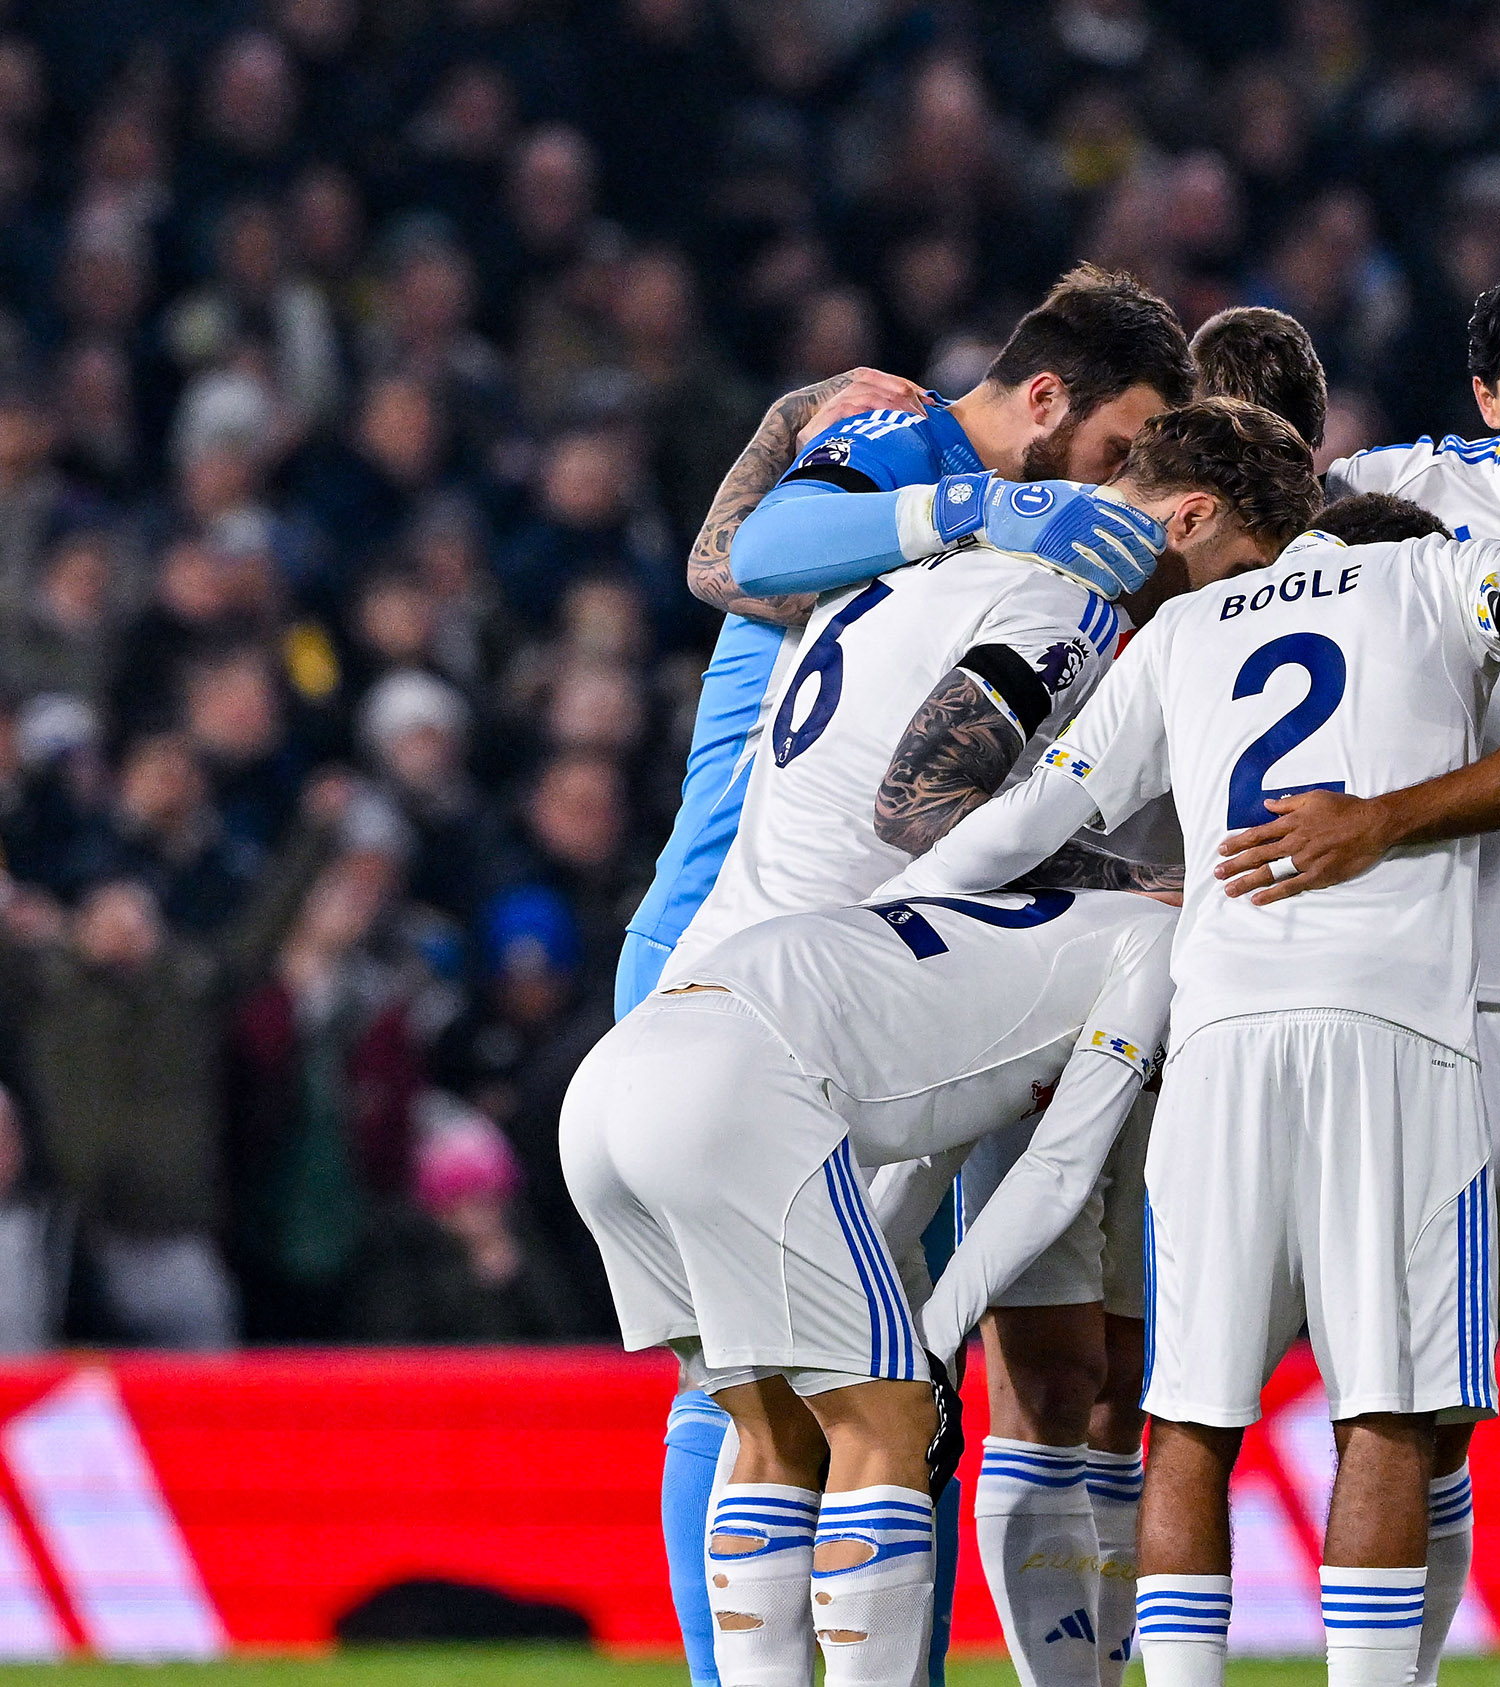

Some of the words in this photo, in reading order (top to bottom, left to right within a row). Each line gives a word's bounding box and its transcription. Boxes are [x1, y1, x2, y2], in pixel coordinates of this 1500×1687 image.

[772, 577, 895, 769] 6
[1219, 564, 1363, 622] BOGLE
[1226, 631, 1348, 832] 2
